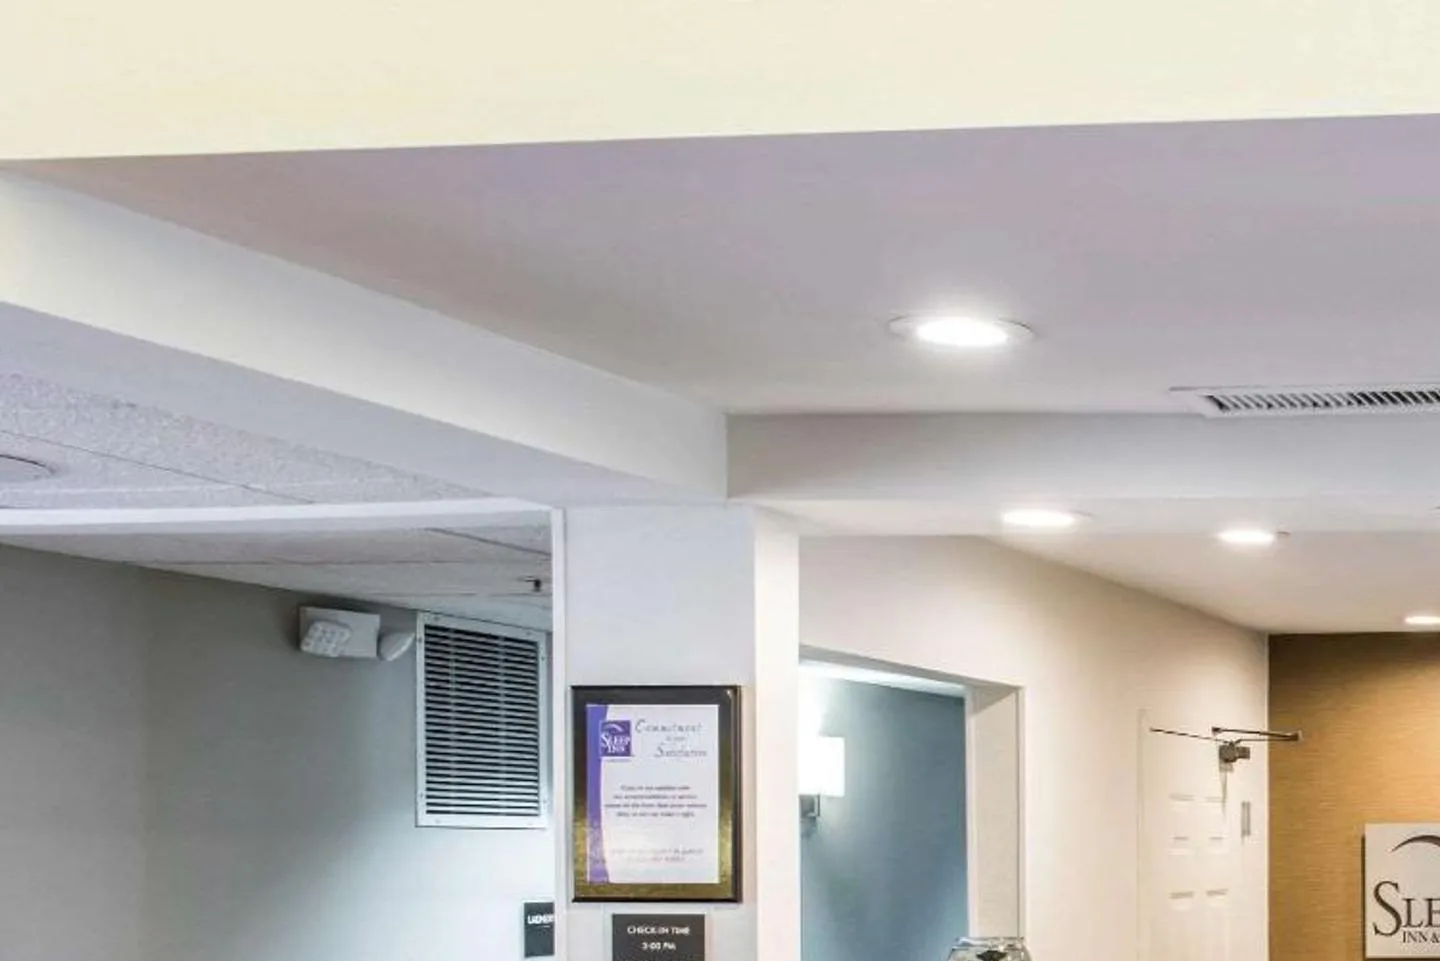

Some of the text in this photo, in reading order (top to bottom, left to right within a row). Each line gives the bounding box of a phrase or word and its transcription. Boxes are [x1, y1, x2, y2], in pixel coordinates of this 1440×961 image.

[601, 732, 631, 748] SLEEP
[671, 926, 691, 935] TIME
[1402, 931, 1428, 943] INN
[1428, 931, 1440, 943] &
